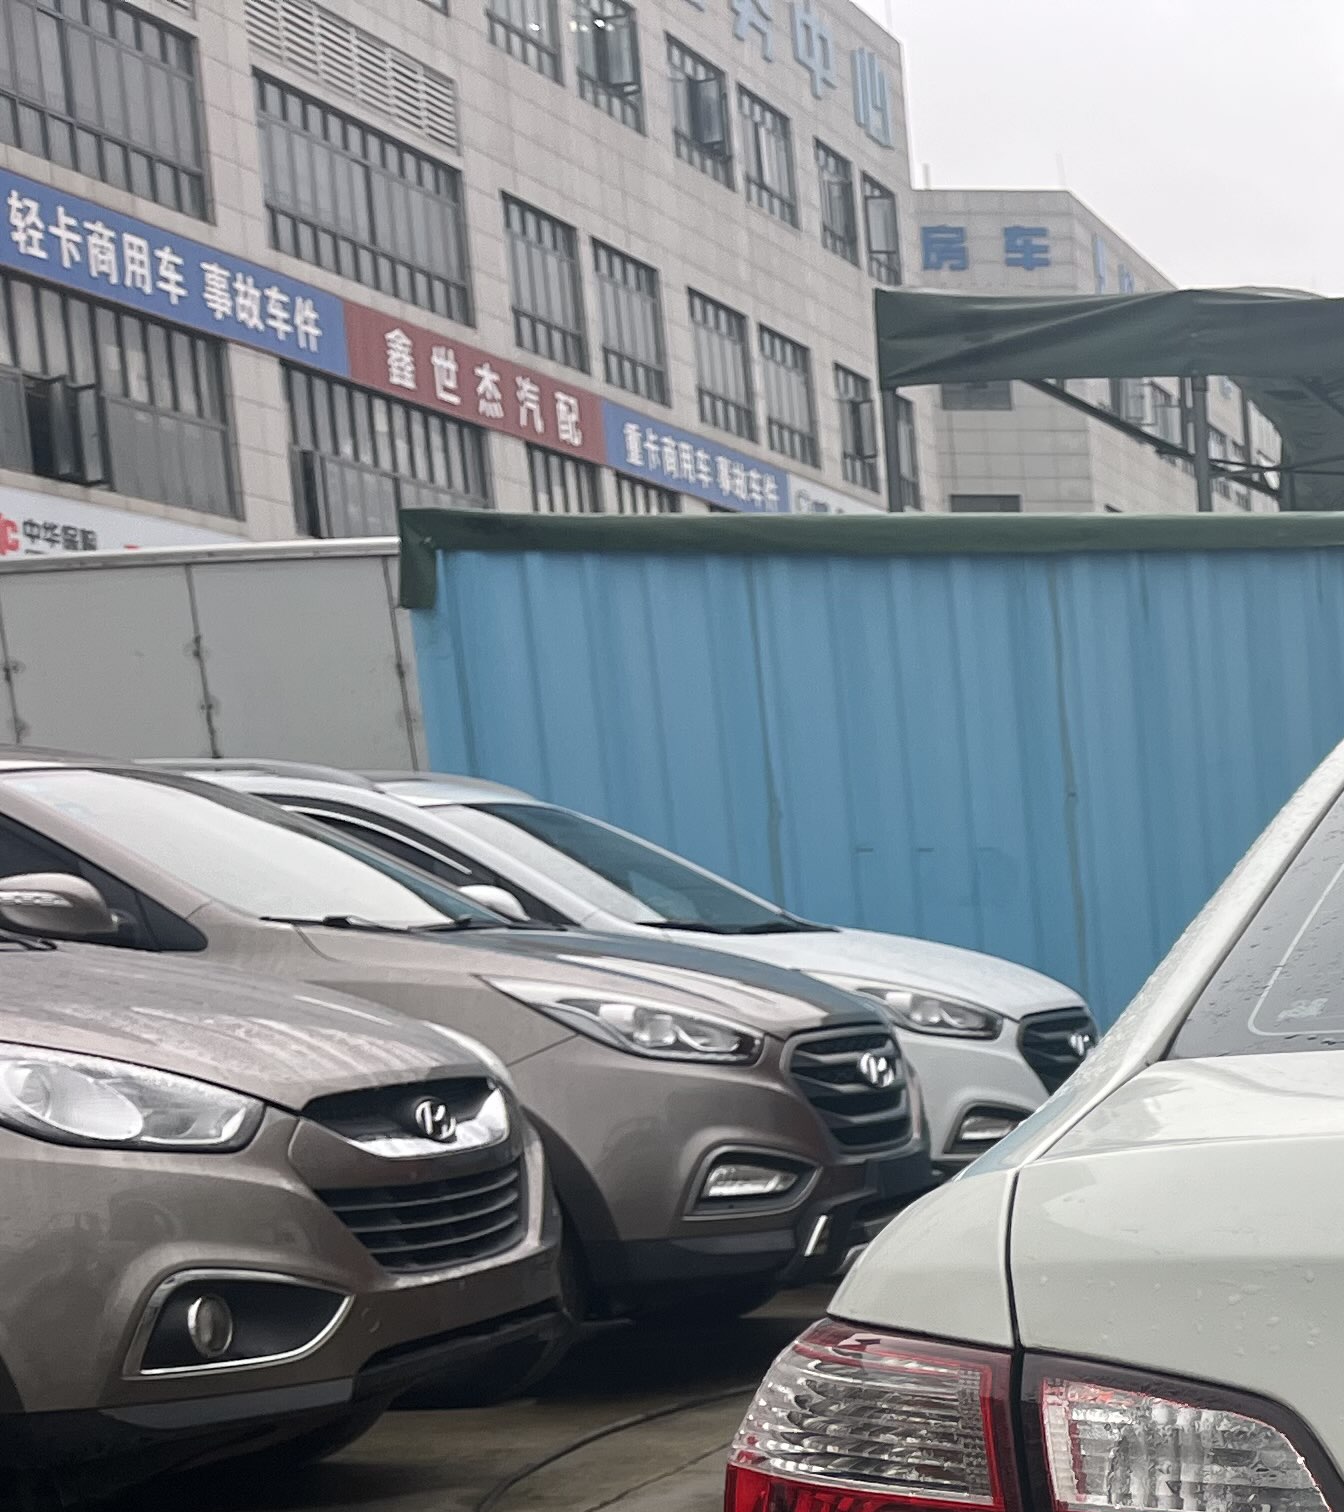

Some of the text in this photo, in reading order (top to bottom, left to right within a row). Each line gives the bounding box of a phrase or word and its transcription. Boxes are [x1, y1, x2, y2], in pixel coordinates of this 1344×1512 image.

[8, 189, 322, 352] 轻卡商用车 事故车件
[384, 328, 583, 447] 鑫世杰汽配
